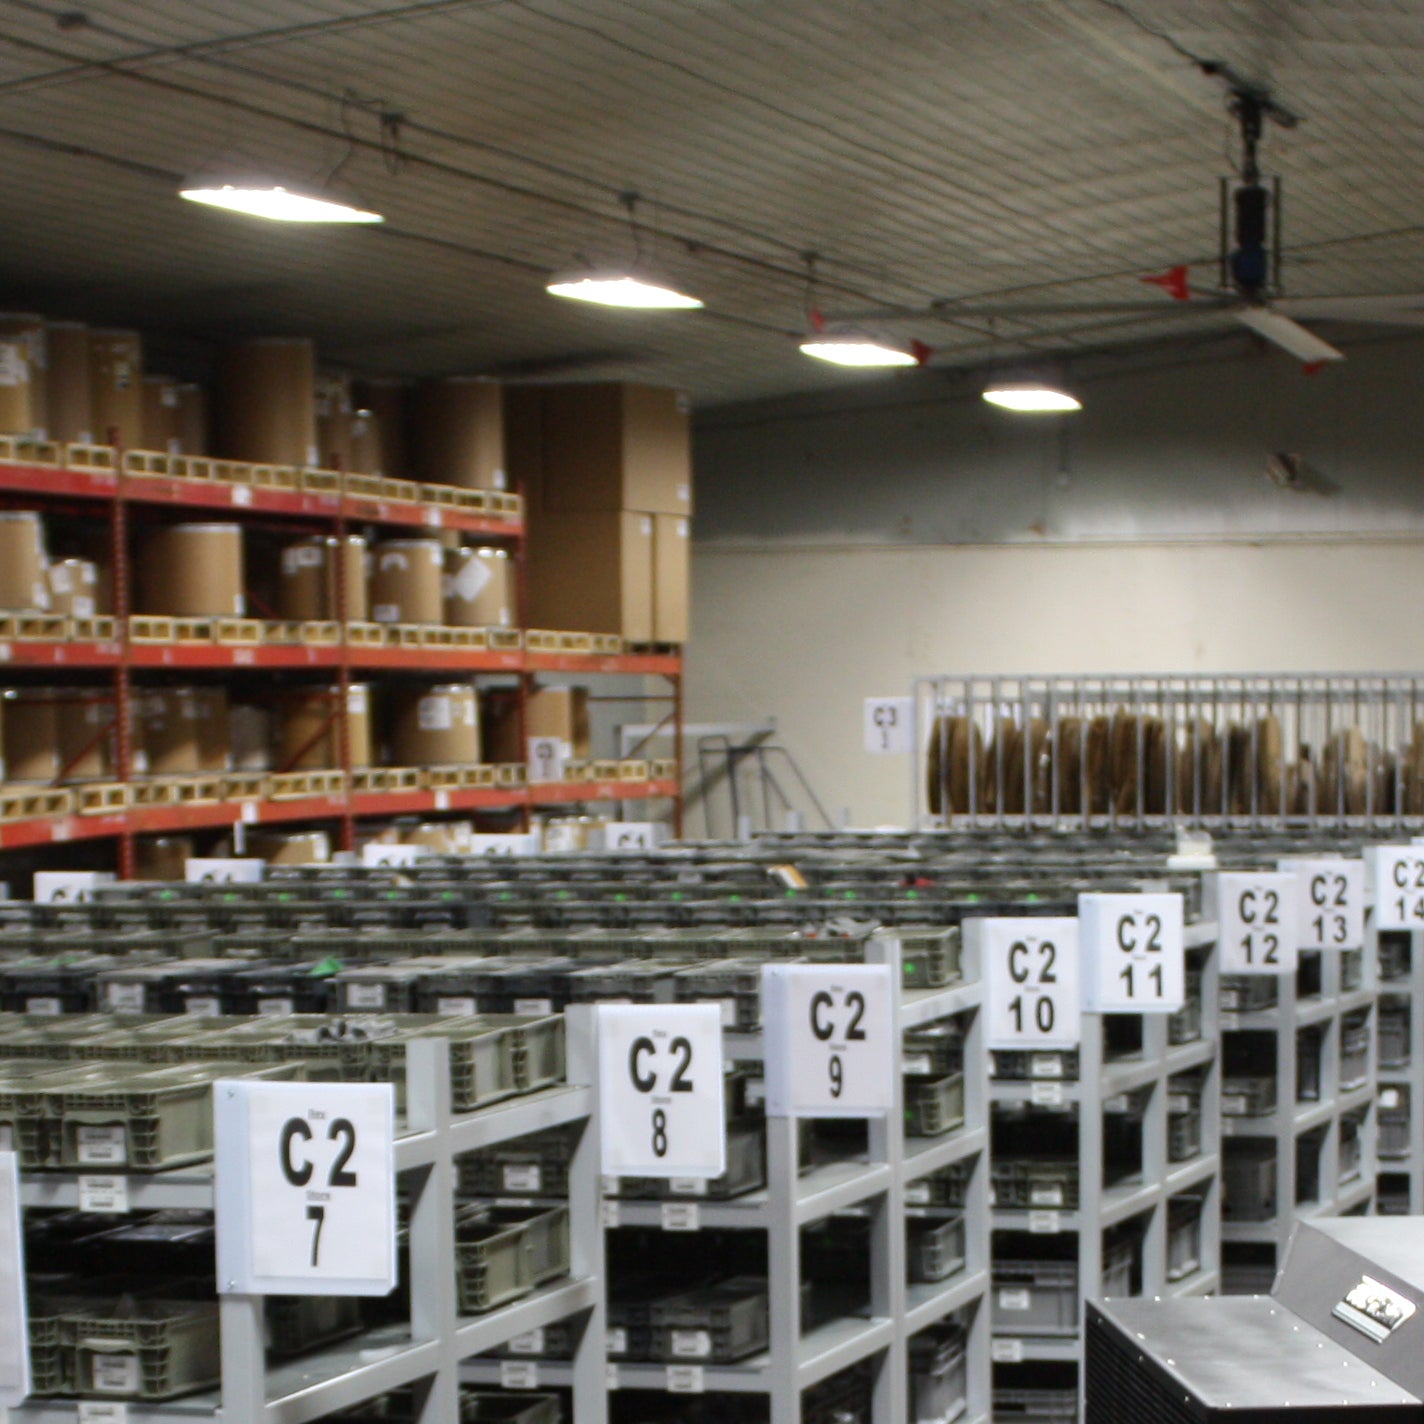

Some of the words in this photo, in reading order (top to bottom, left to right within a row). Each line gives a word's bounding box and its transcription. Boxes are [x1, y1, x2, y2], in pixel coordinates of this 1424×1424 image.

[829, 1056, 843, 1098] 9
[652, 1108, 668, 1159] 8
[307, 1205, 325, 1267] 7
